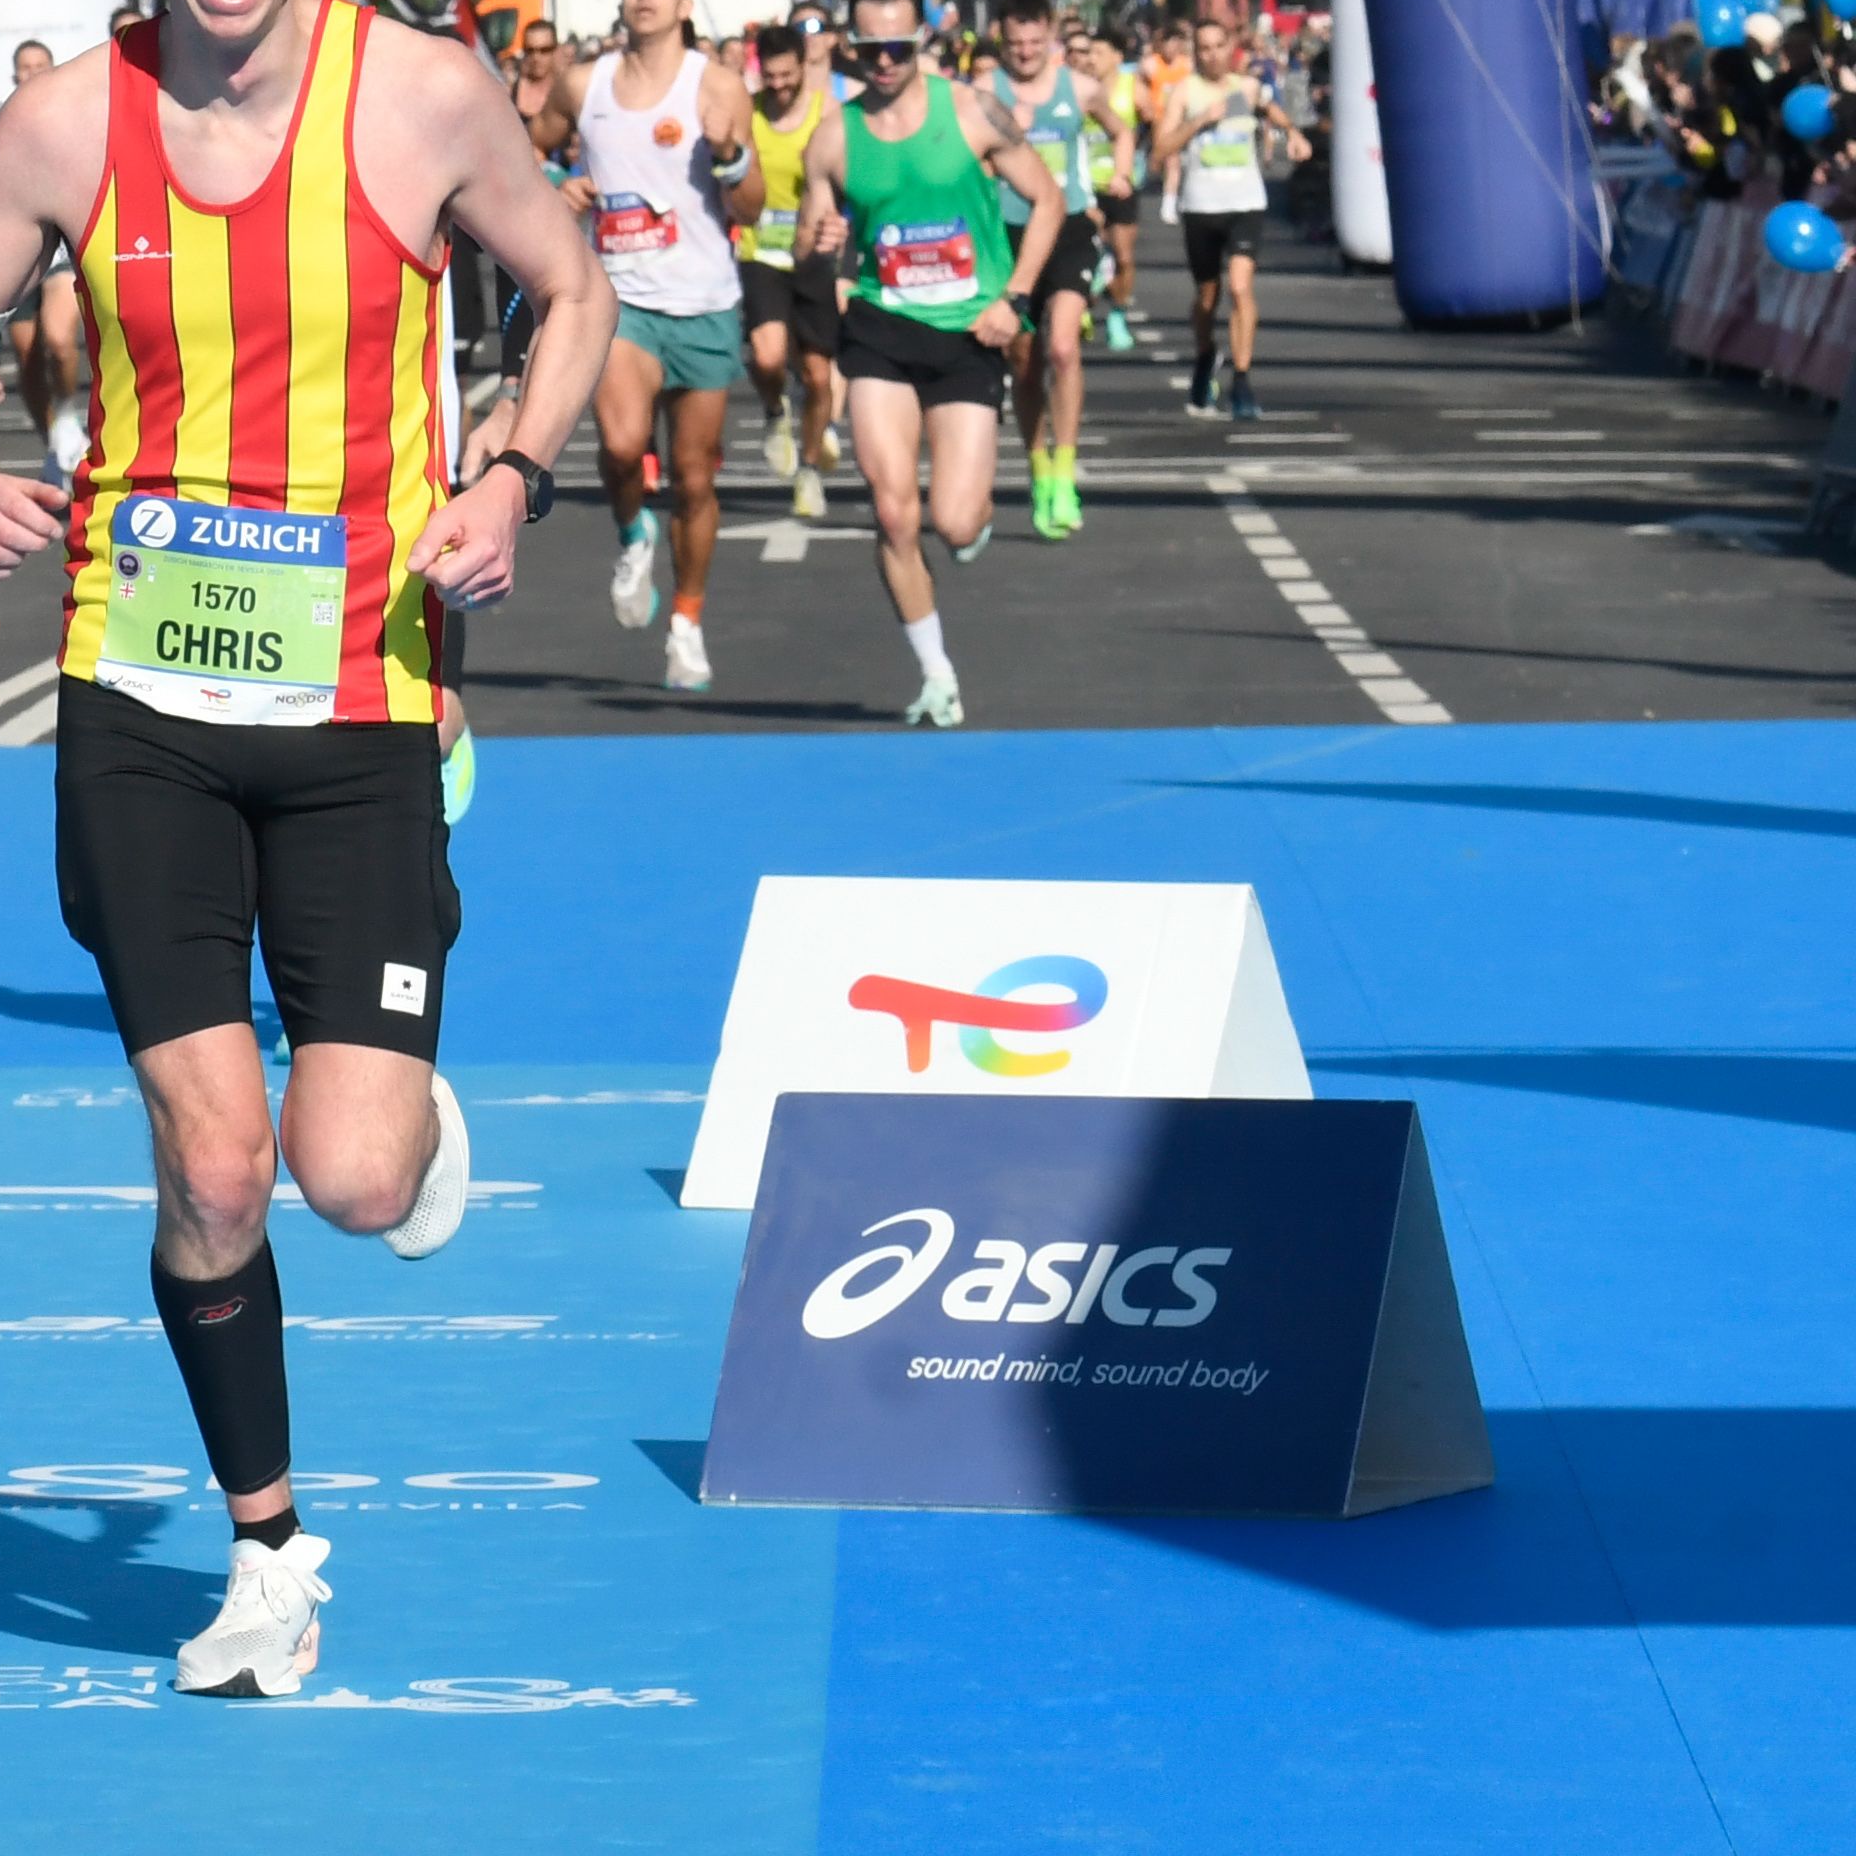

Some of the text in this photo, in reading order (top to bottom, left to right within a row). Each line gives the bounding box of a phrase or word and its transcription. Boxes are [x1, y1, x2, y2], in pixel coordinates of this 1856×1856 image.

[190, 516, 321, 555] ZURICH
[191, 580, 257, 614] 1570
[156, 620, 283, 673] CHRIS
[940, 1239, 1233, 1328] asics
[906, 1351, 1270, 1396] sound mind, sound body
[308, 1501, 587, 1511] SEVILLA
